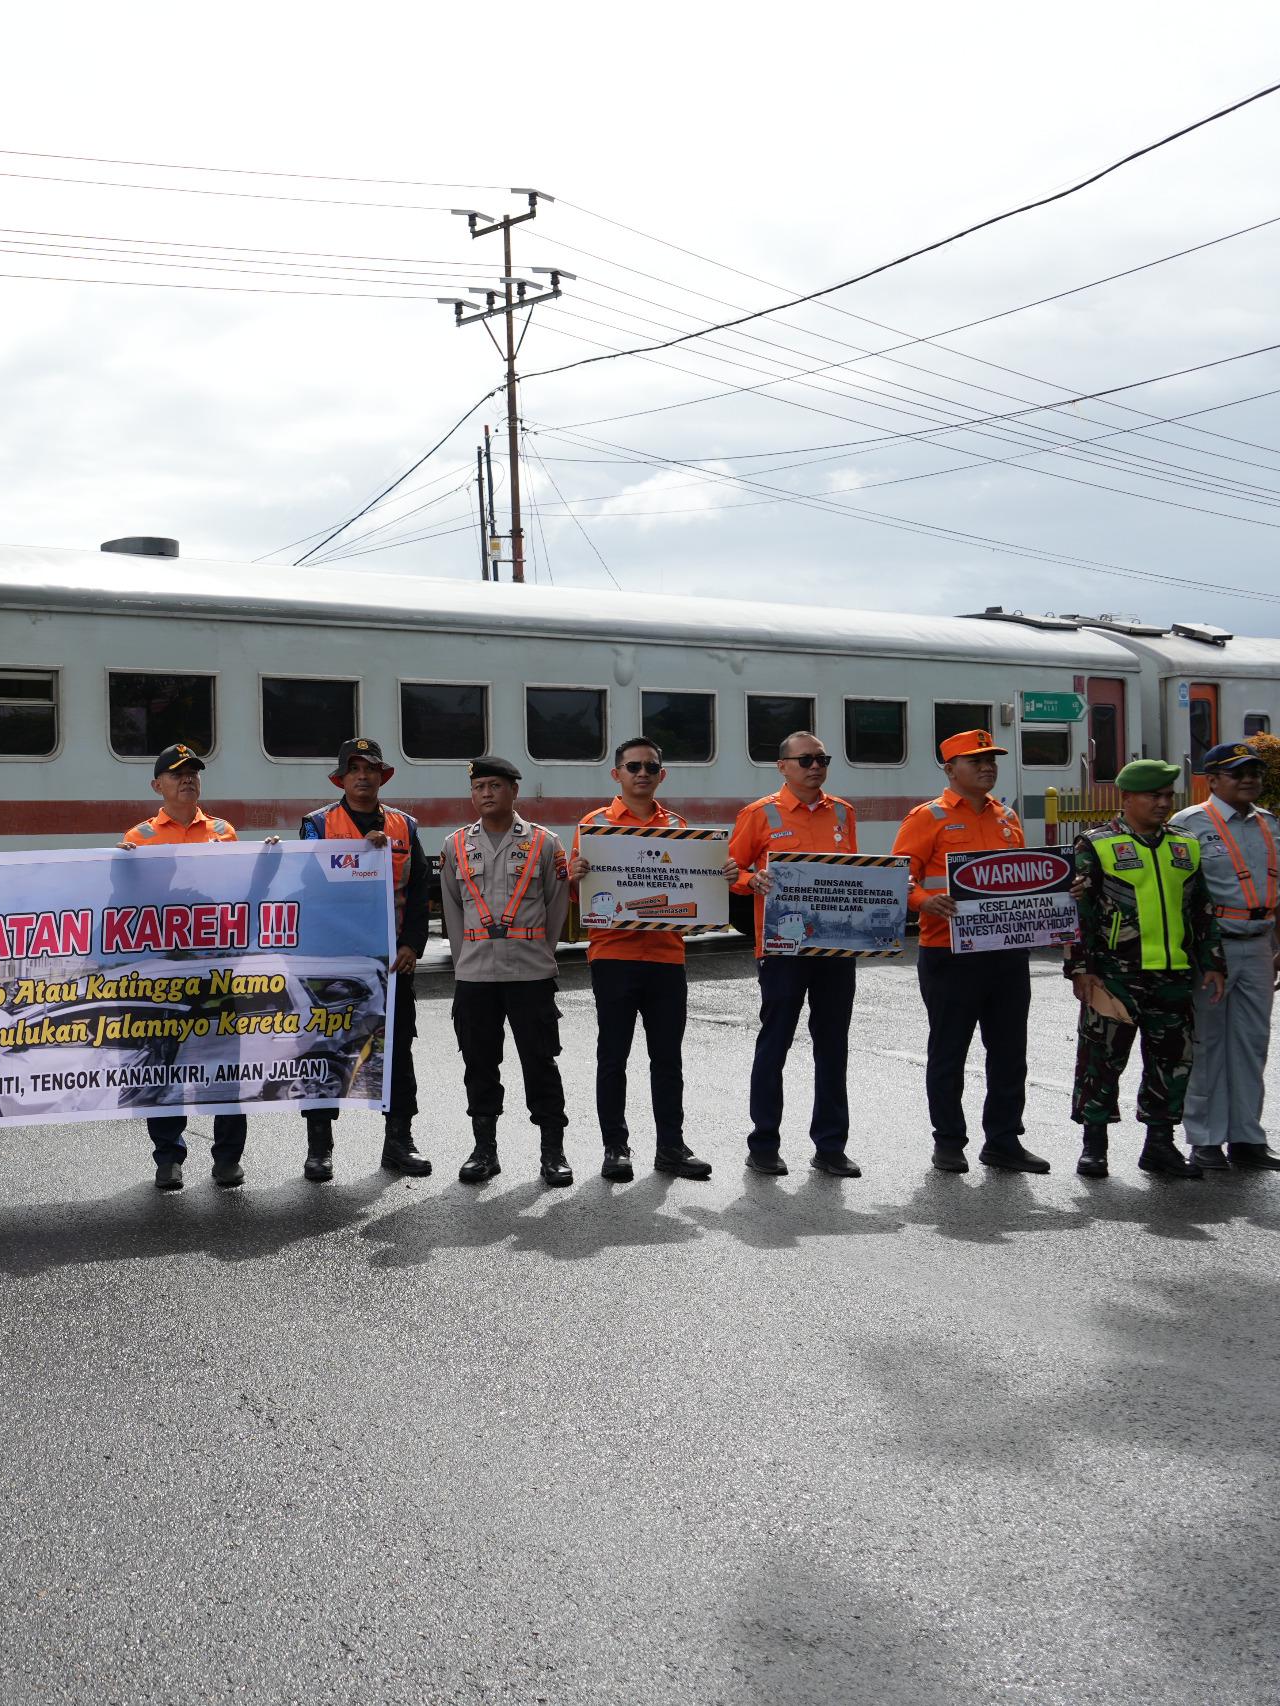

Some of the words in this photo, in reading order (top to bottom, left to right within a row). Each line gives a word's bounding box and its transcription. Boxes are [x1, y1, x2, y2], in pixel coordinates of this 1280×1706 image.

[352, 870, 378, 878] Properti
[589, 864, 667, 874] EKERAS-KERASNYA
[669, 867, 688, 875] HATI
[689, 868, 723, 876] MANTAN
[972, 860, 1054, 886] WARNING
[616, 880, 644, 888] BADAN
[783, 886, 845, 895] BERHENTILAH
[847, 889, 893, 897] SEBENTAR
[814, 879, 863, 888] DUNSANAK
[775, 894, 800, 902] AGAR
[802, 895, 850, 904] BERJUMPA
[852, 897, 899, 905] KELUARGA
[979, 897, 1053, 913] KESELAMATAN
[955, 916, 966, 926] DI
[967, 911, 1036, 925] PERLINTASAN
[1038, 906, 1076, 919] ADALAH
[103, 903, 249, 954] KAREH
[259, 901, 300, 949] !!!
[958, 923, 1011, 938] INVESTASI
[1013, 919, 1046, 932] UNTUK
[1047, 918, 1075, 930] HIDUP
[1004, 933, 1035, 945] ANDA!
[13, 978, 78, 1005] Atau
[85, 971, 201, 1003] Katingga
[209, 969, 286, 995] Namo
[93, 1012, 210, 1047] Jalannyo
[216, 1009, 300, 1035] Kereta
[304, 1005, 354, 1037] Api
[30, 1070, 100, 1092] TENGOK
[106, 1067, 165, 1087] KANAN
[170, 1065, 209, 1085] KIRI,
[215, 1063, 263, 1082] AMAN
[269, 1059, 328, 1081] JALAN)
